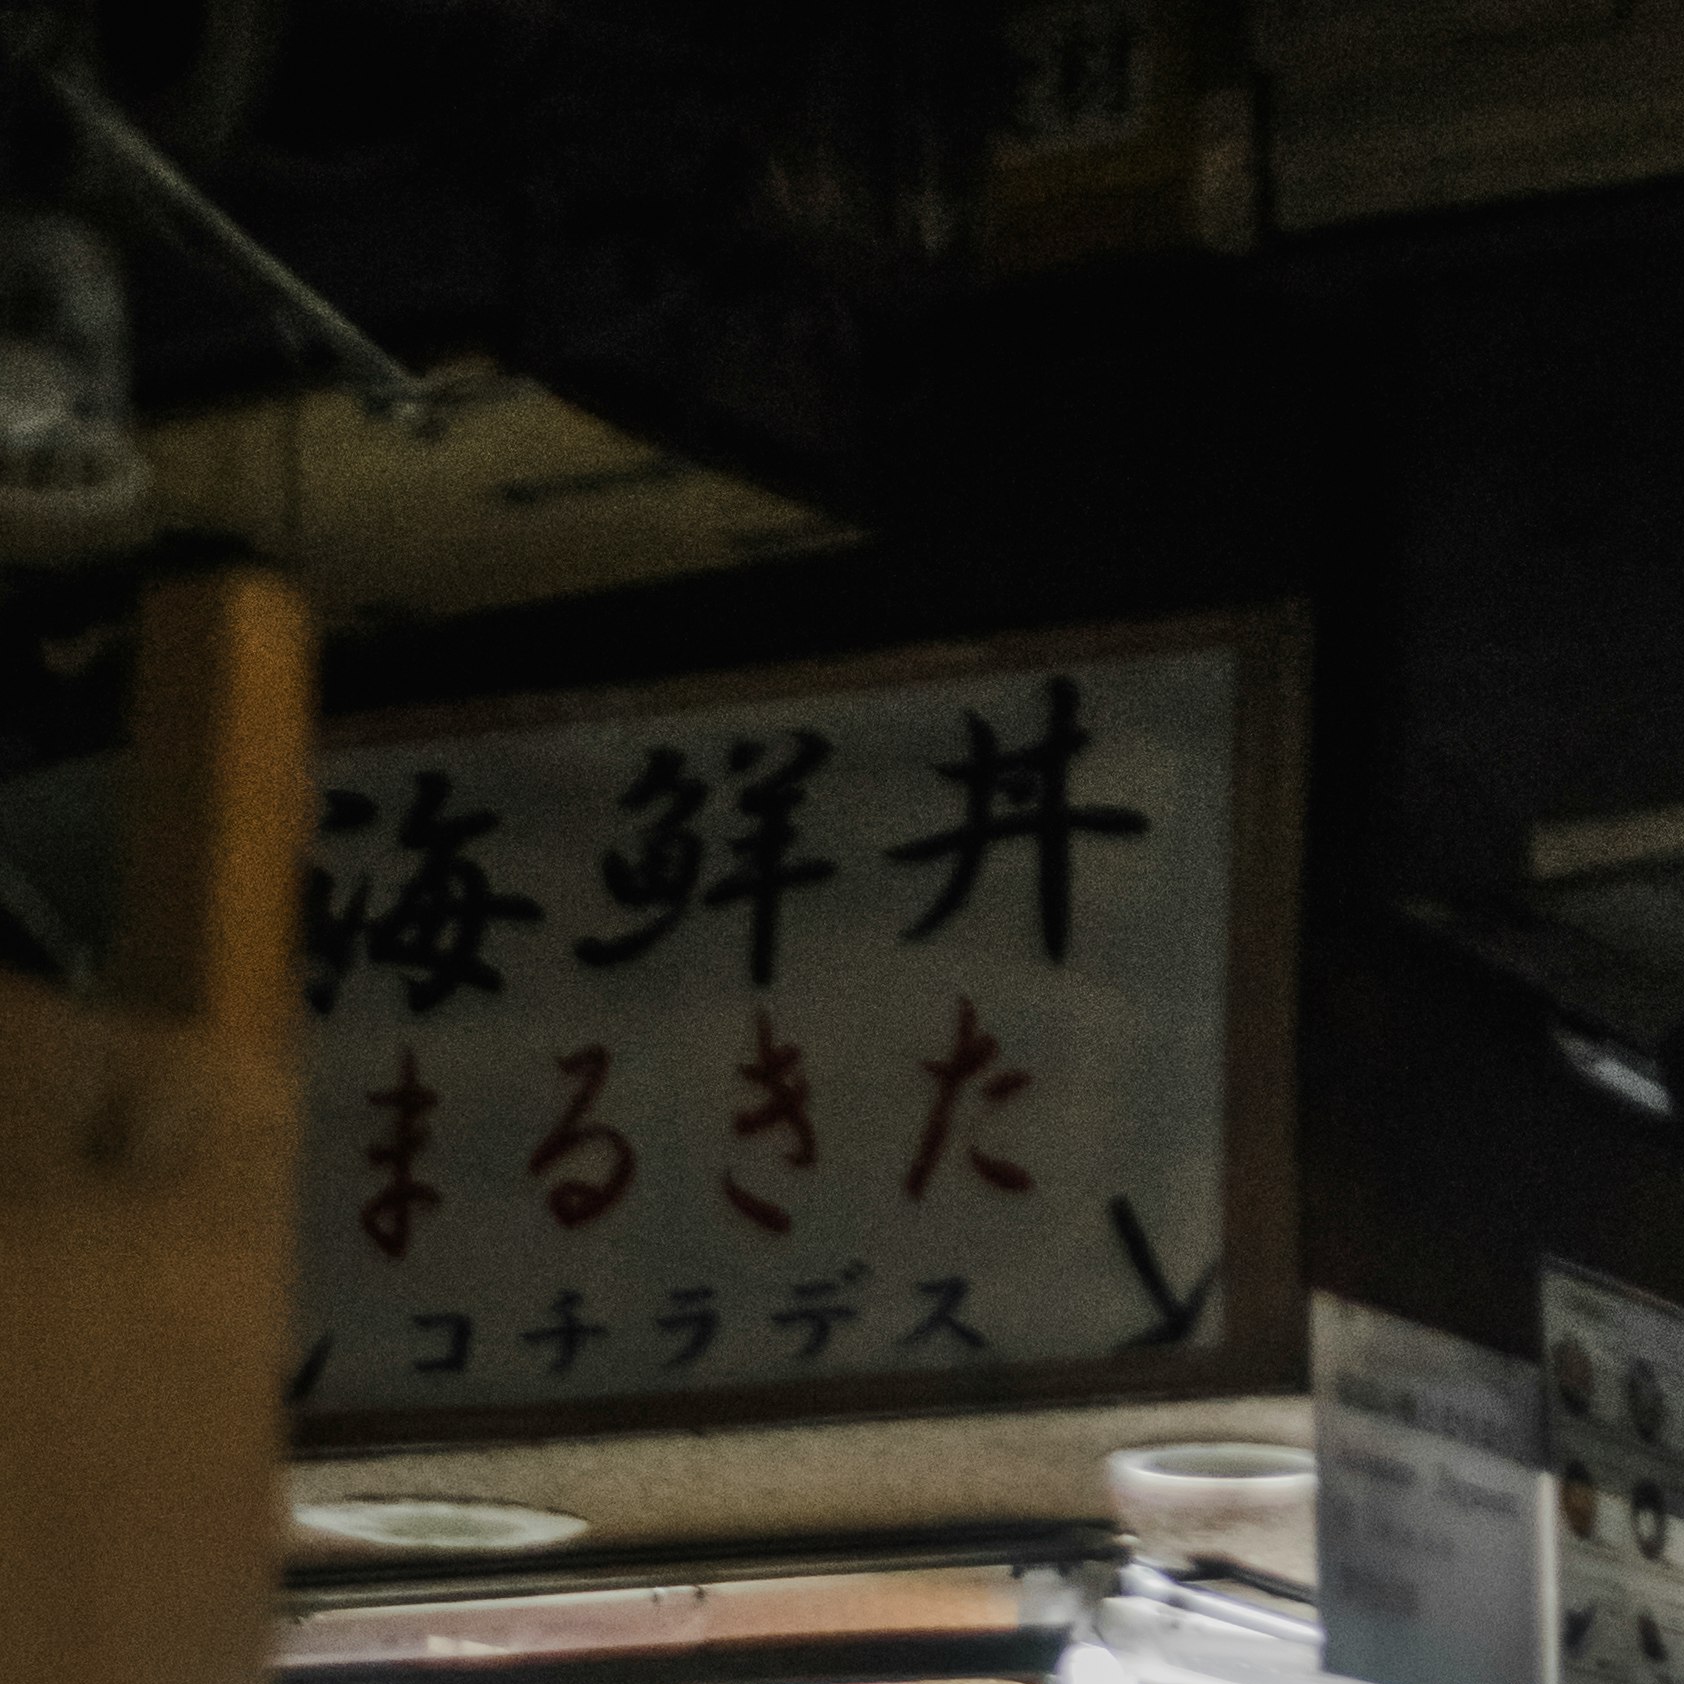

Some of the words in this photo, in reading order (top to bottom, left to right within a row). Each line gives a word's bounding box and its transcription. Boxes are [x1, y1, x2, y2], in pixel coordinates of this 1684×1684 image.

[360, 998, 1038, 1258] まるきた
[410, 1263, 990, 1376] コチラデス
